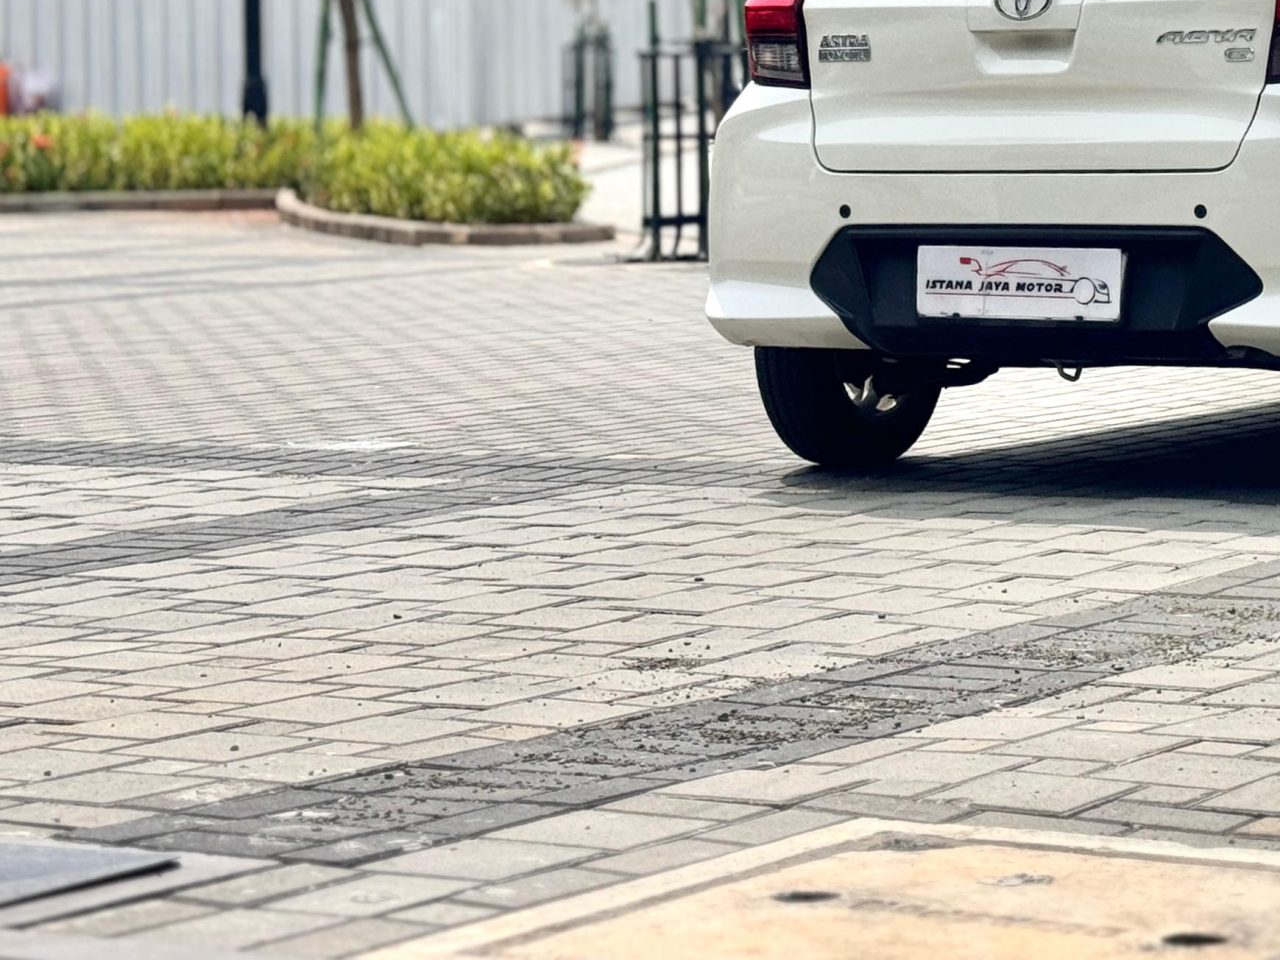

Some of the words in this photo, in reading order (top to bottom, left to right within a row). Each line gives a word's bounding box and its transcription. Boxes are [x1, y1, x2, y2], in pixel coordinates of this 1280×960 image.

[819, 35, 869, 48] ASTRA
[925, 279, 973, 291] ISTANA
[978, 280, 1010, 292] JAYA
[1015, 281, 1063, 293] MOTOR
